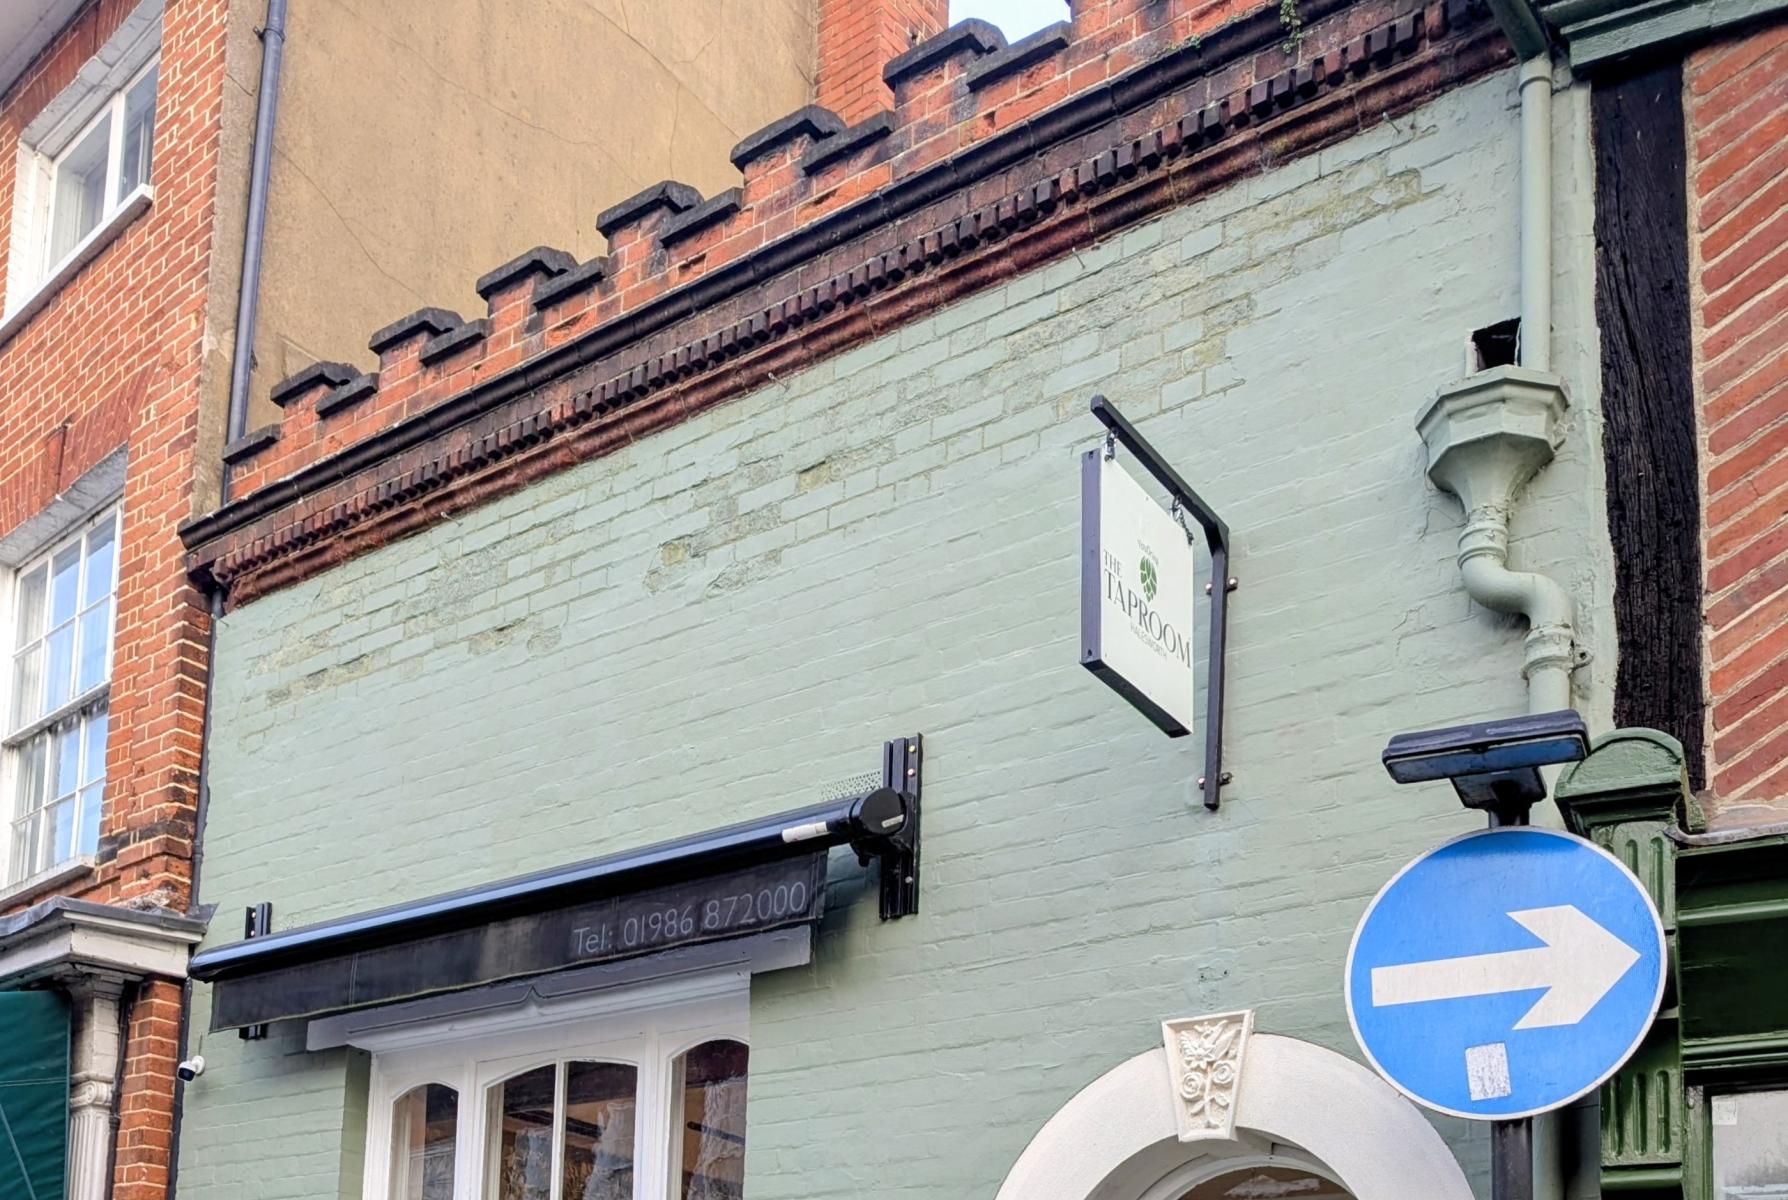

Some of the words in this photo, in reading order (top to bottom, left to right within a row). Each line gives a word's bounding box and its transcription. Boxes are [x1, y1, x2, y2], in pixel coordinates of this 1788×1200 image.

[1103, 549, 1122, 578] THE
[1104, 568, 1191, 668] TAPROOM
[573, 922, 613, 955] Tel:
[623, 905, 694, 946] 01986
[704, 881, 806, 930] 872000
